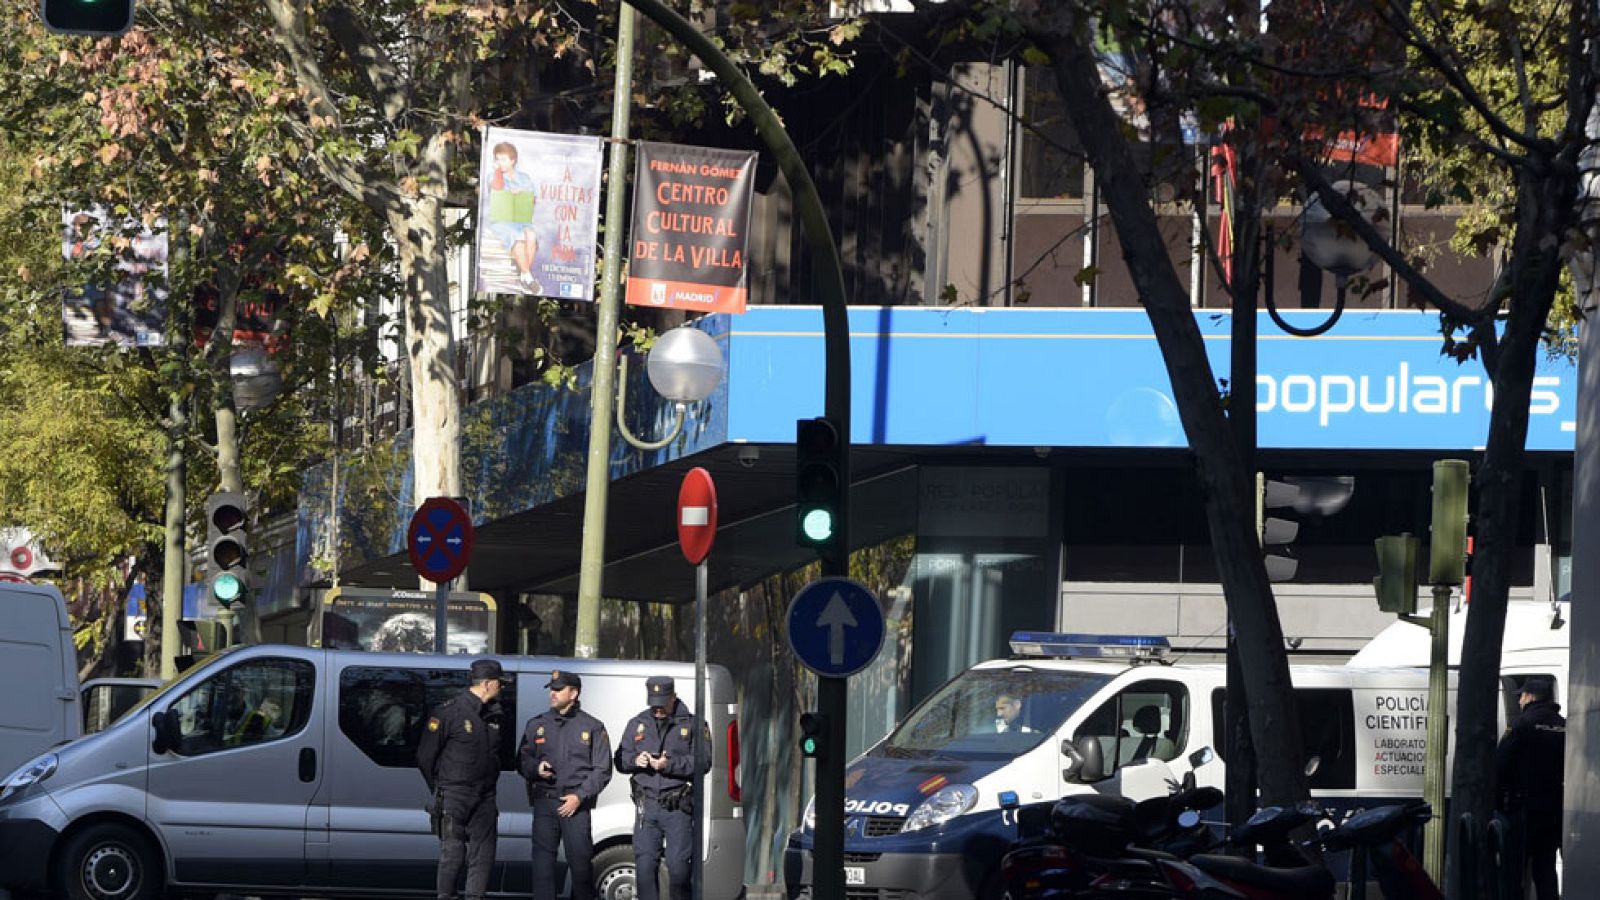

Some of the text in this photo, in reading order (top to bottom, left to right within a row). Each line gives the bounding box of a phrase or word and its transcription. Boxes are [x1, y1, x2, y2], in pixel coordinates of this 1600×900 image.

[562, 164, 573, 182] A
[650, 159, 697, 176] FERNÁN
[540, 183, 594, 204] VUELTAS
[657, 181, 730, 206] CENTRO
[554, 205, 577, 221] CON
[556, 224, 571, 241] LA
[646, 210, 737, 237] CULTURAL
[635, 240, 742, 269] DE LA VILLA
[1375, 694, 1429, 711] POLICÍ
